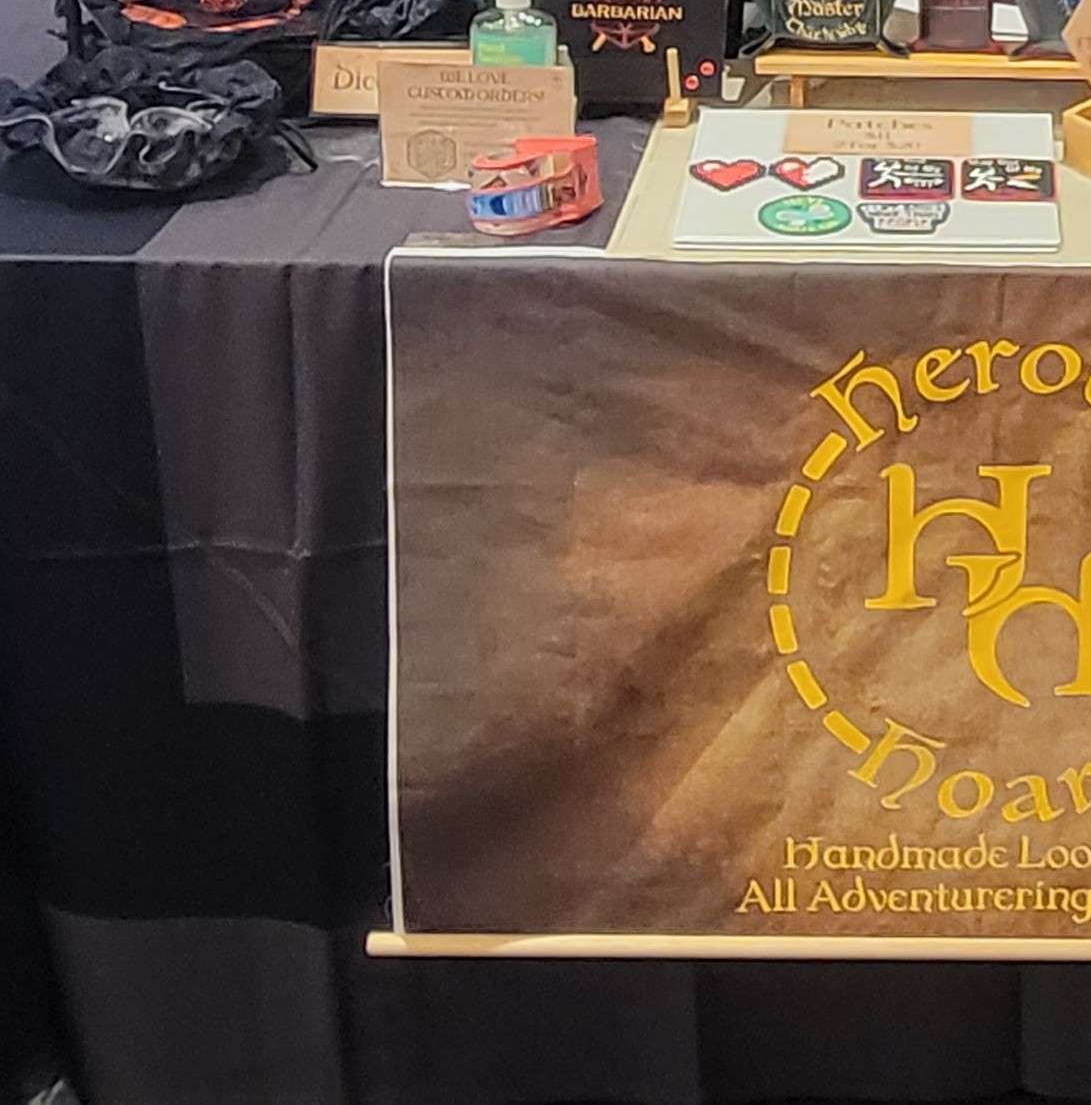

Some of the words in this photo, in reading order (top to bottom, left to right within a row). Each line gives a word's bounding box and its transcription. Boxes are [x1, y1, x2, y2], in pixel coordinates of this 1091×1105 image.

[570, 2, 684, 21] BARBARIAN
[333, 63, 377, 92] Dic
[784, 834, 1009, 871] Handmade
[734, 877, 797, 913] All
